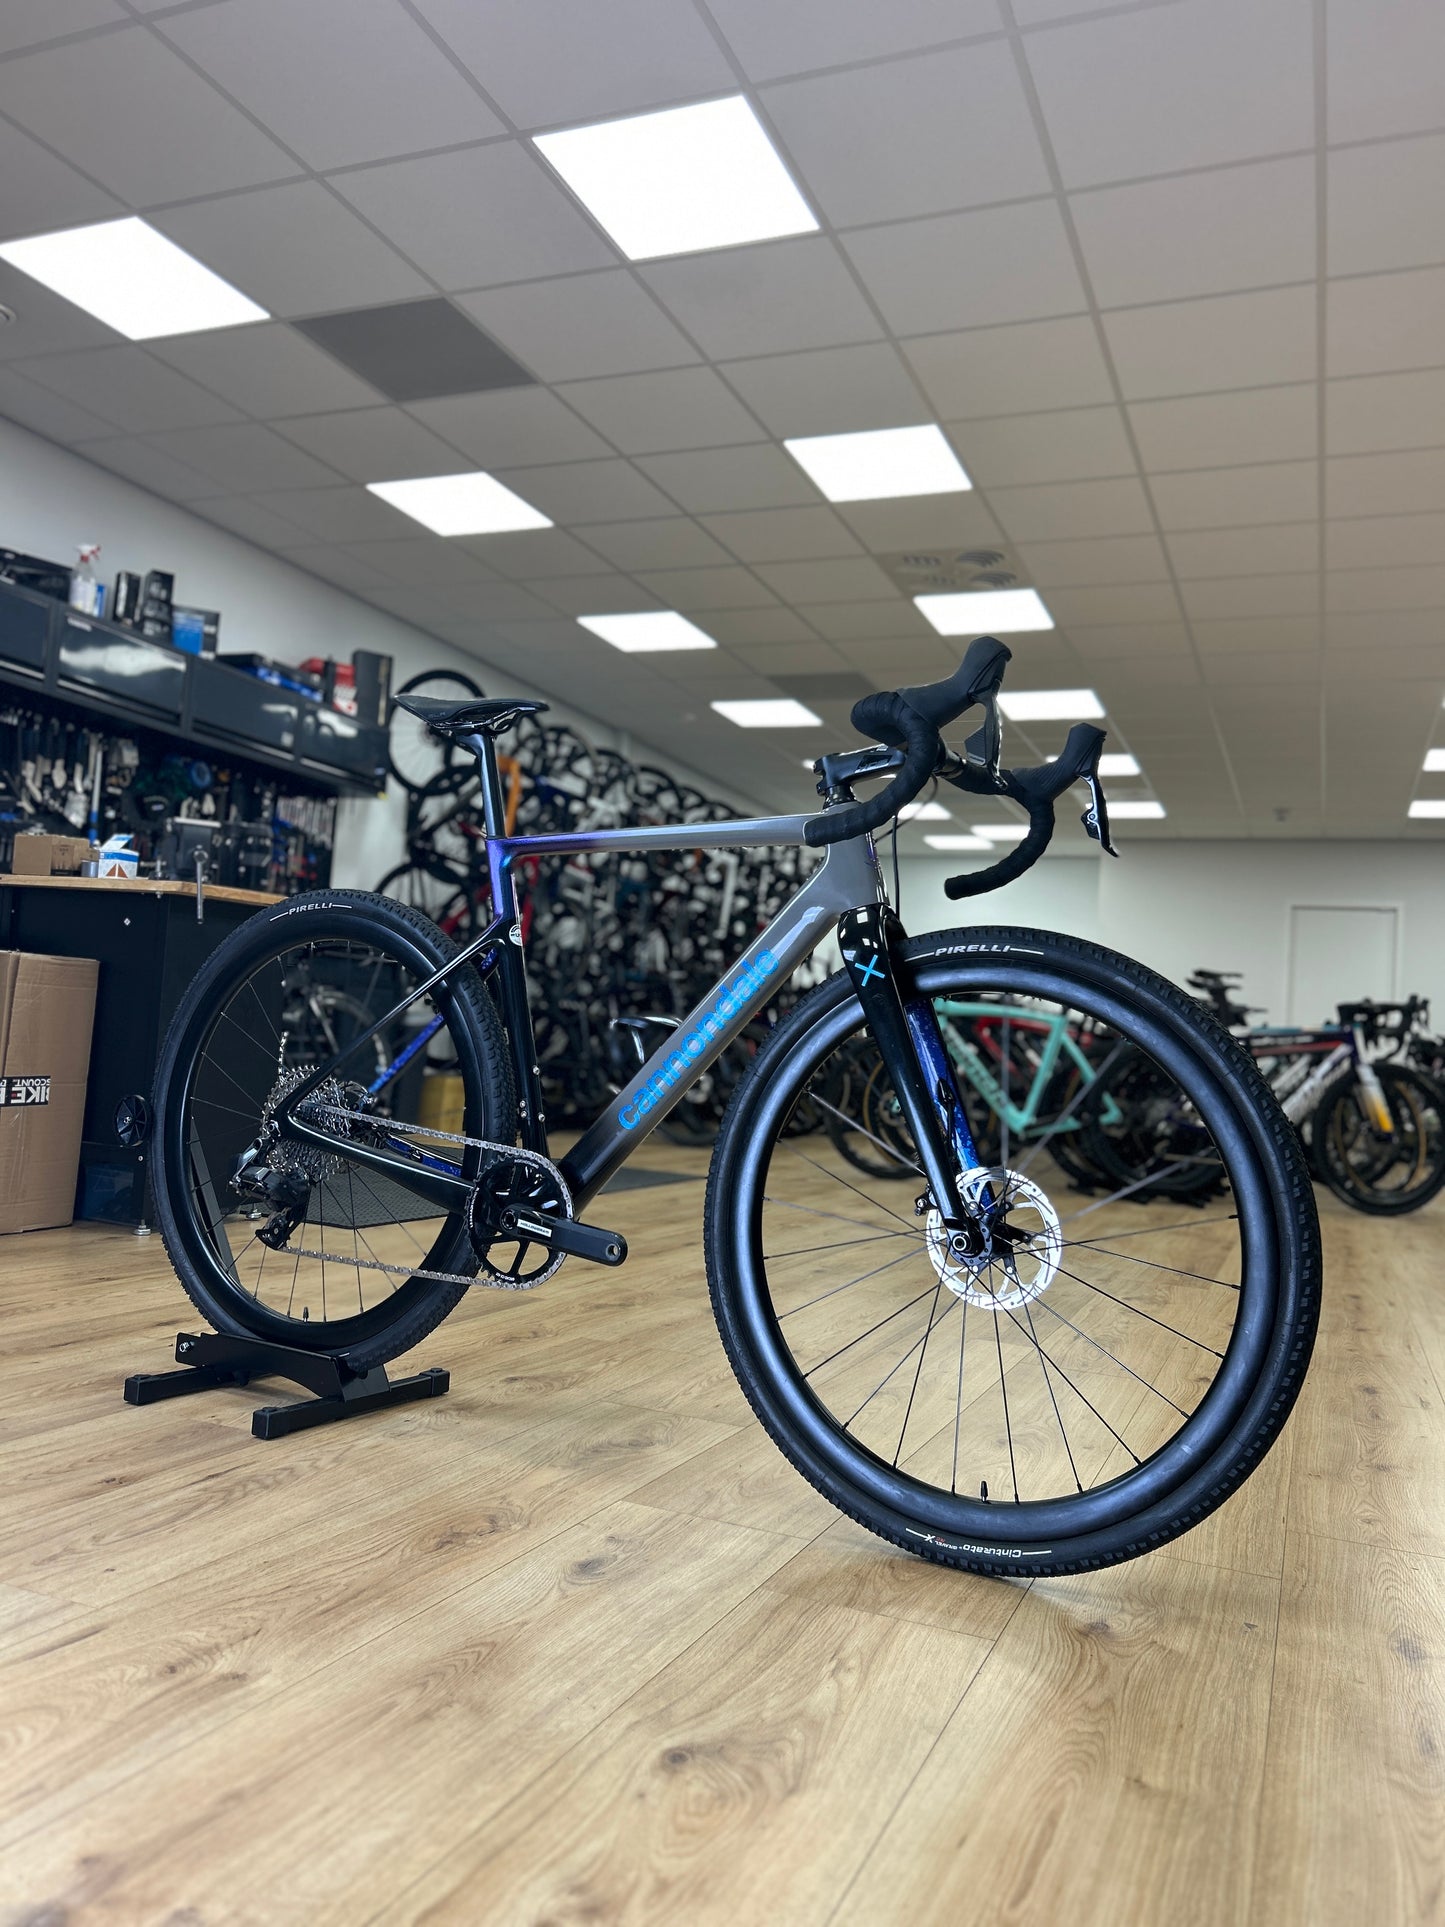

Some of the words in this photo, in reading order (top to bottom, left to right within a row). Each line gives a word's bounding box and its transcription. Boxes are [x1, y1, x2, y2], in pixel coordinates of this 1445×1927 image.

[289, 902, 333, 916] PIRELLI
[935, 944, 1011, 957] PIRELLI
[617, 949, 779, 1131] cannondale
[962, 1543, 1022, 1558] Cinturato
